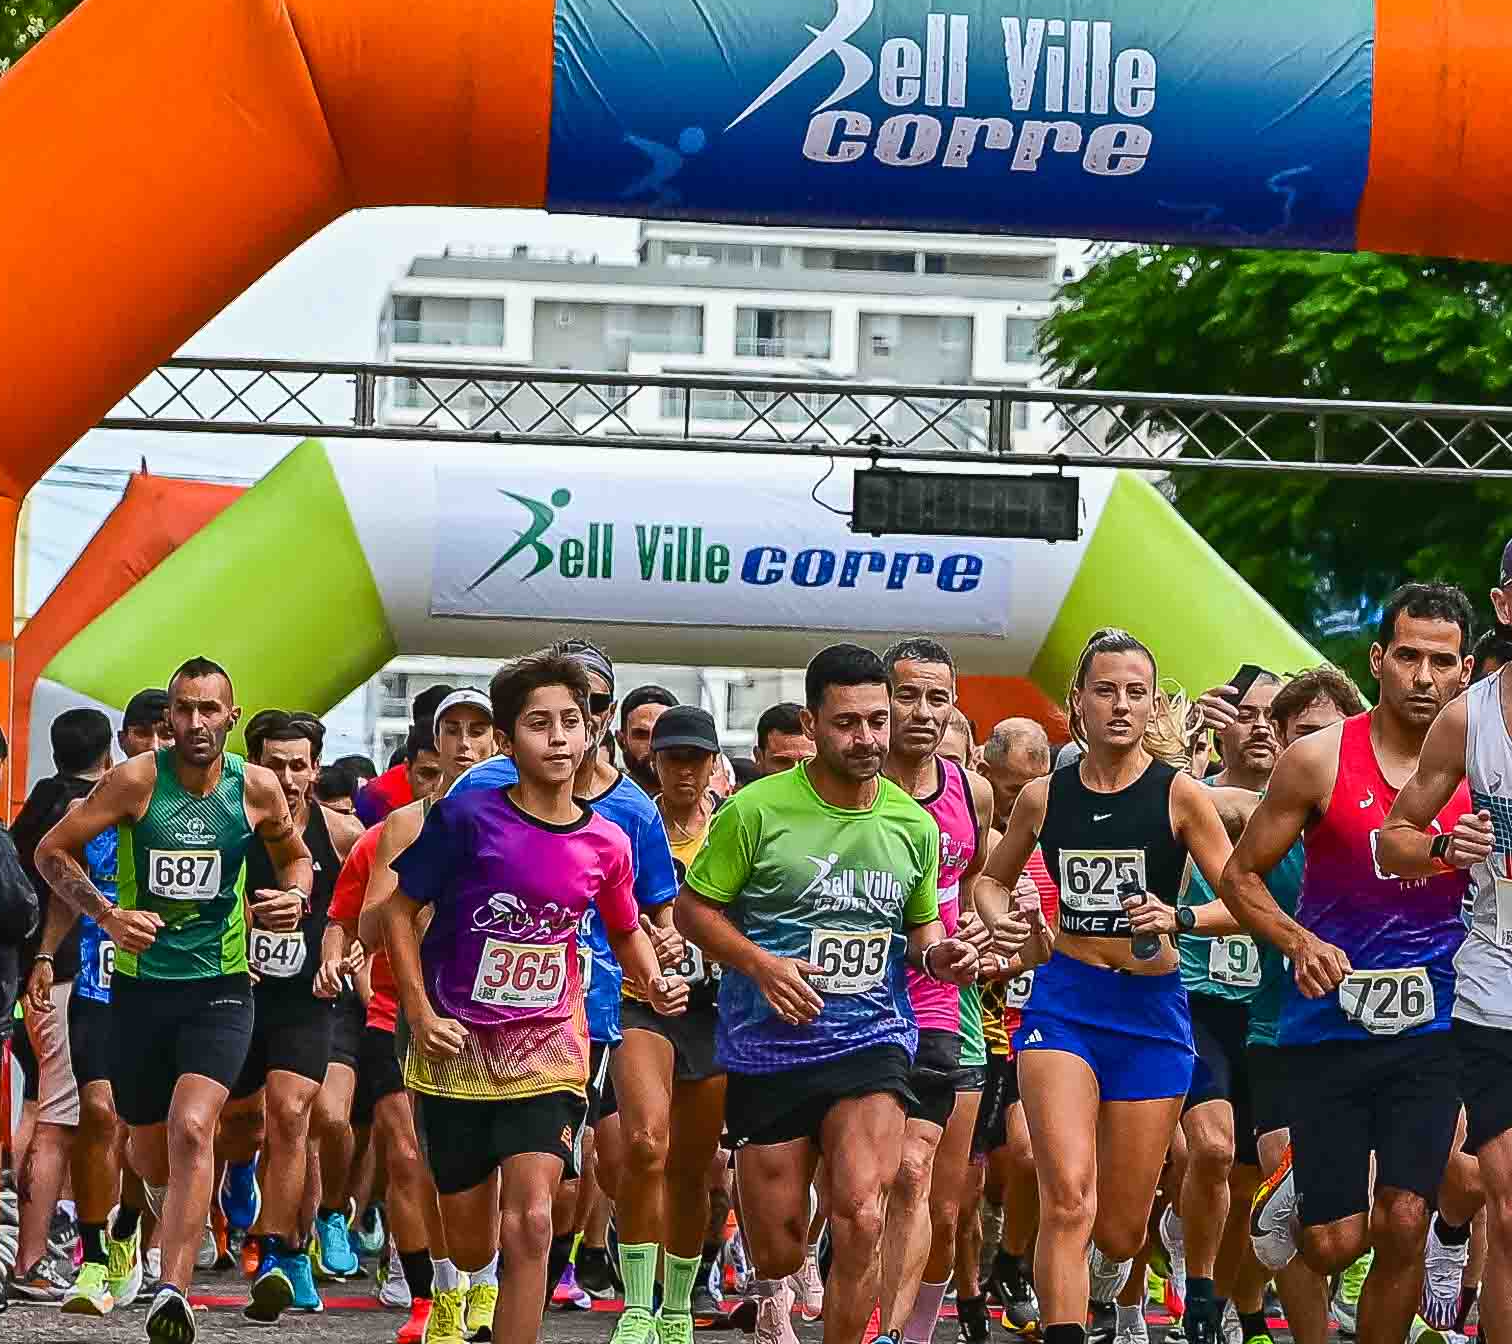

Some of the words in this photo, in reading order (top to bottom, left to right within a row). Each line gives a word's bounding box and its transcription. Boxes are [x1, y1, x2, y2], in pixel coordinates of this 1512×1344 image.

[1001, 16, 1157, 118] Ville
[802, 109, 1153, 177] corre
[635, 522, 731, 584] Ville
[739, 545, 985, 593] corre
[155, 856, 215, 887] 687
[1062, 917, 1108, 932] NIKE
[255, 935, 302, 967] 647
[483, 948, 561, 992] 365
[818, 937, 886, 978] 693
[1347, 974, 1426, 1019] 726
